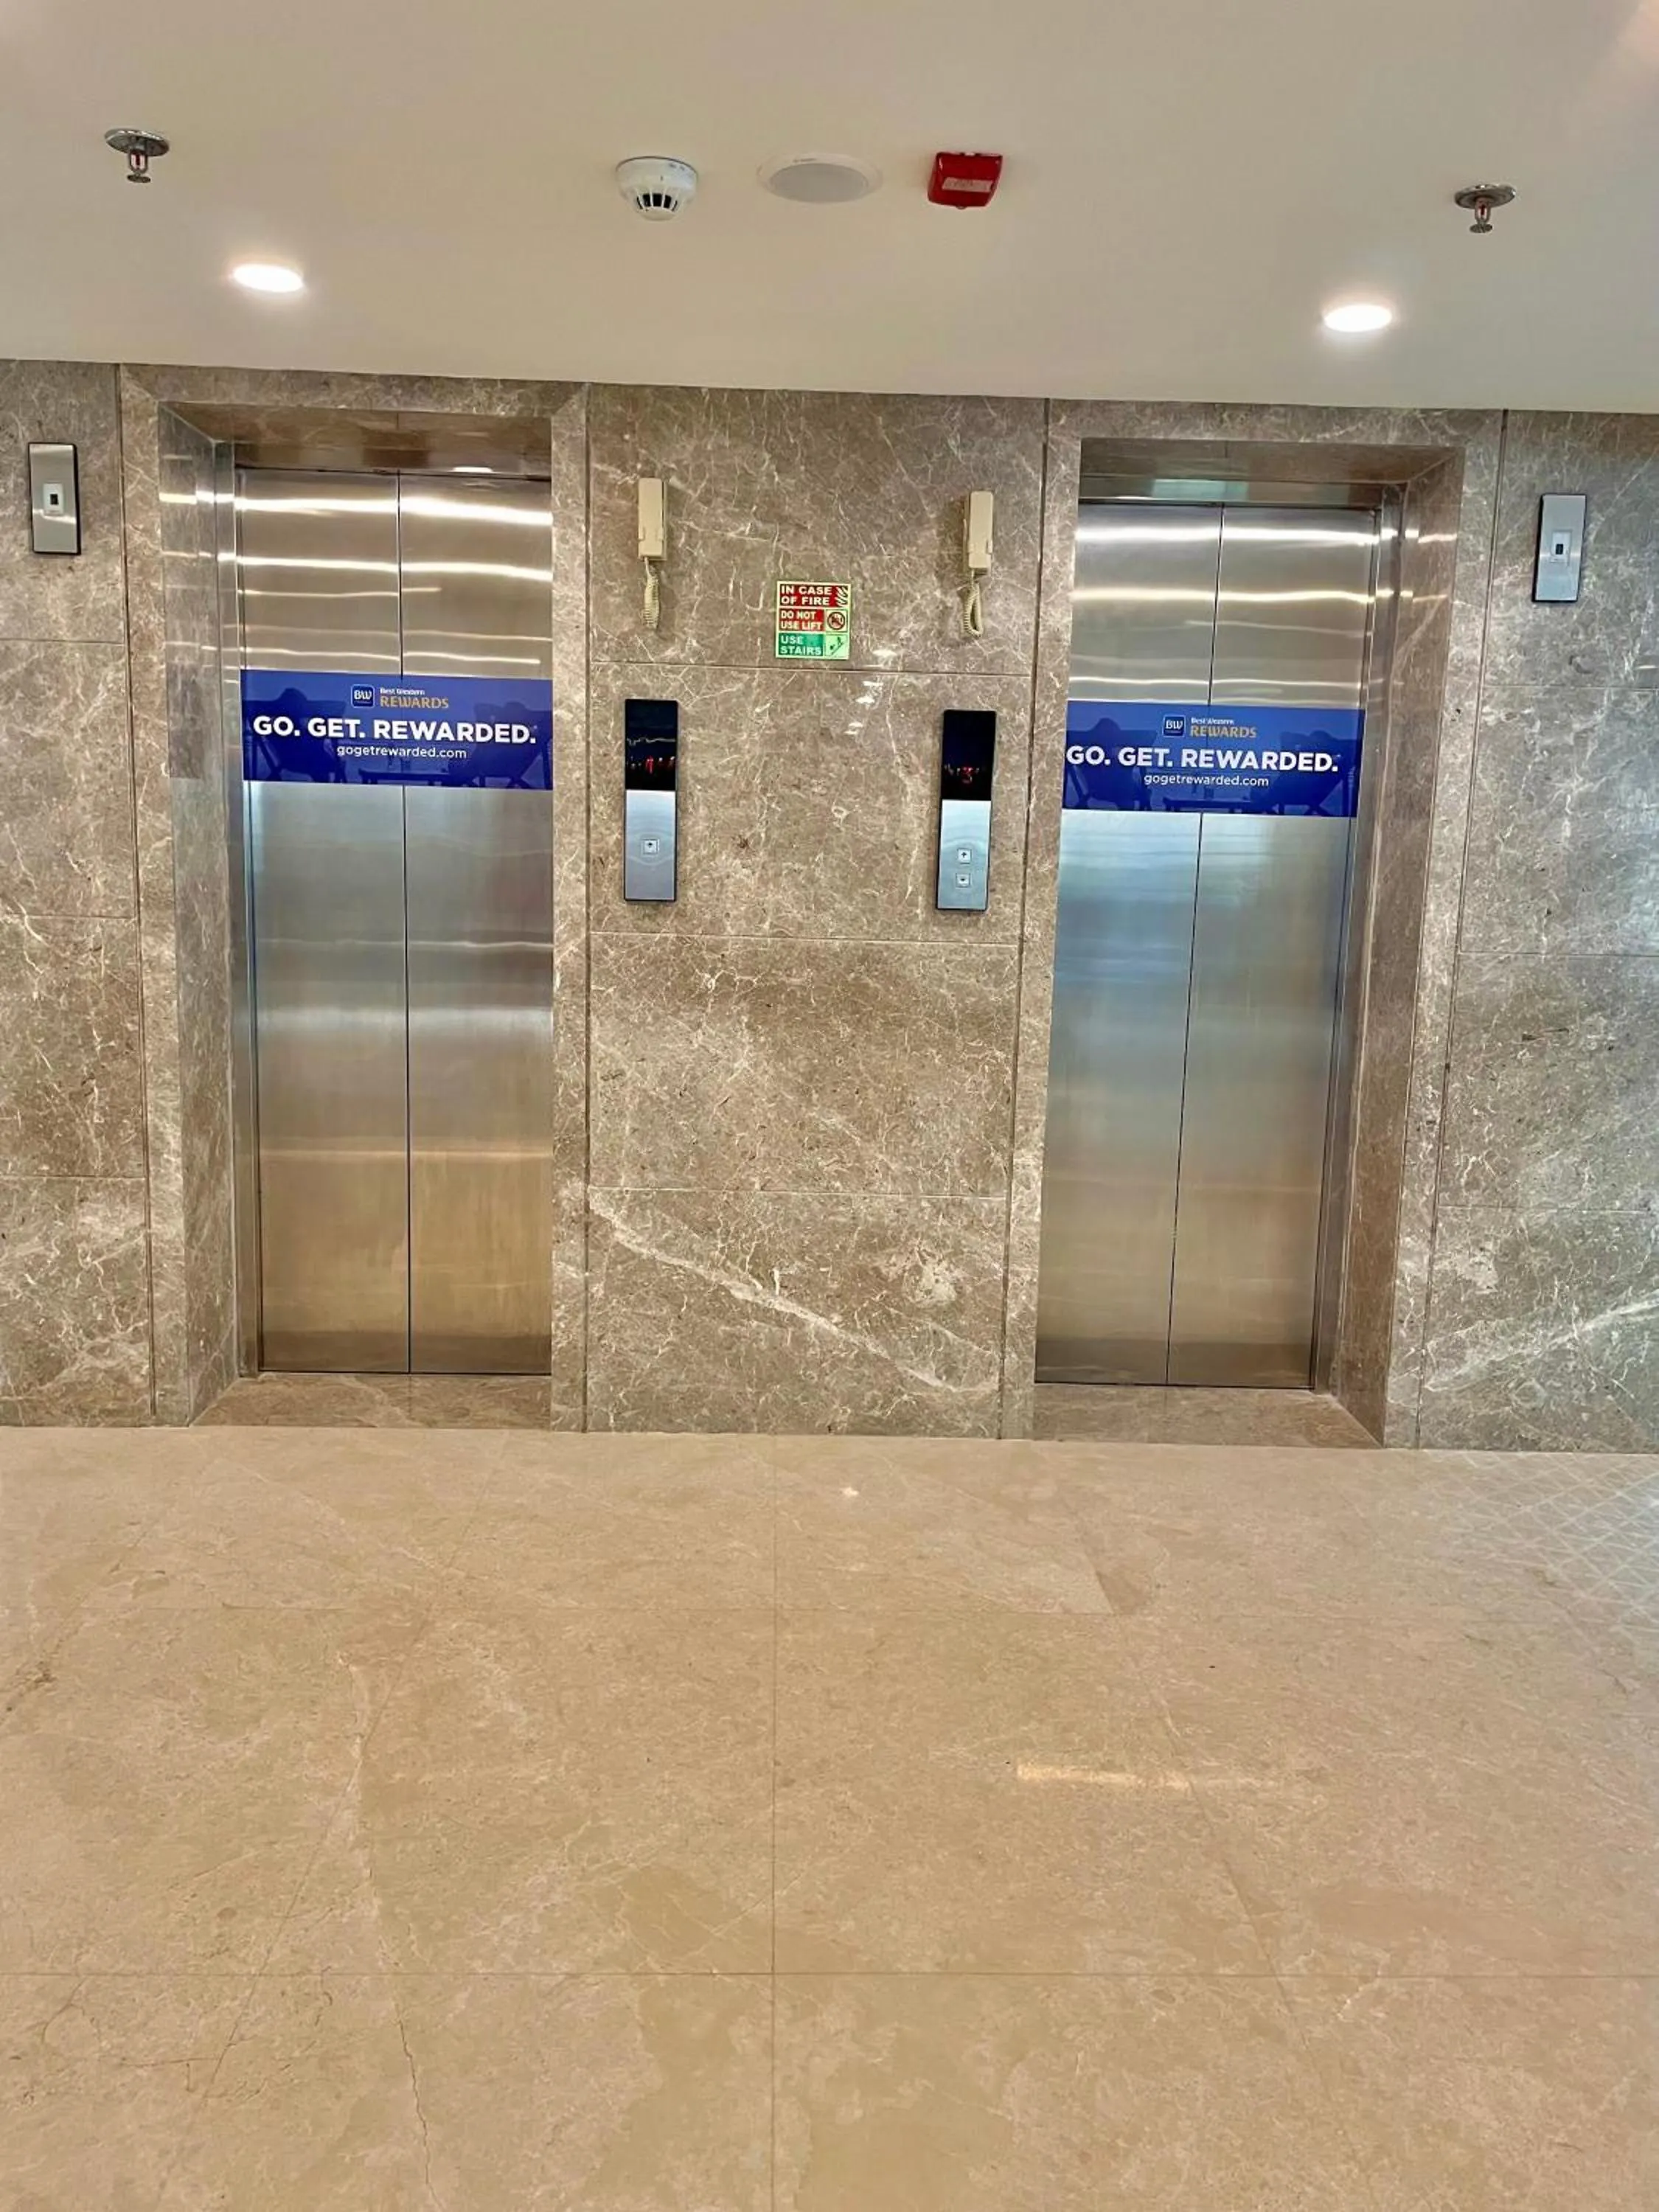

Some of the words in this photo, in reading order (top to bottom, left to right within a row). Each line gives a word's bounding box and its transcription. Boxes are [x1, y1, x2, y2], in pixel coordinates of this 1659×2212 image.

[781, 585, 795, 594] IN
[799, 586, 832, 595] CASE
[781, 596, 796, 605] OF
[801, 597, 830, 605] FIRE
[781, 611, 794, 619] DO
[797, 611, 816, 619] NOT
[781, 621, 799, 629] USE
[801, 622, 823, 630] LIFT
[781, 635, 804, 644] USE
[780, 645, 822, 655] STAIRS
[380, 696, 449, 709] REWARDS
[253, 715, 300, 737] GO.
[307, 717, 366, 739] GET.
[373, 720, 537, 744] REWARDED.
[1166, 720, 1183, 730] BW
[1191, 725, 1257, 738] REWARDS
[337, 745, 467, 759] gogetrewarded.com
[1066, 745, 1110, 765] GO.
[1117, 747, 1172, 768] GET.
[1180, 749, 1339, 772] REWARDED.
[1144, 773, 1269, 787] gogetrewarded.com
